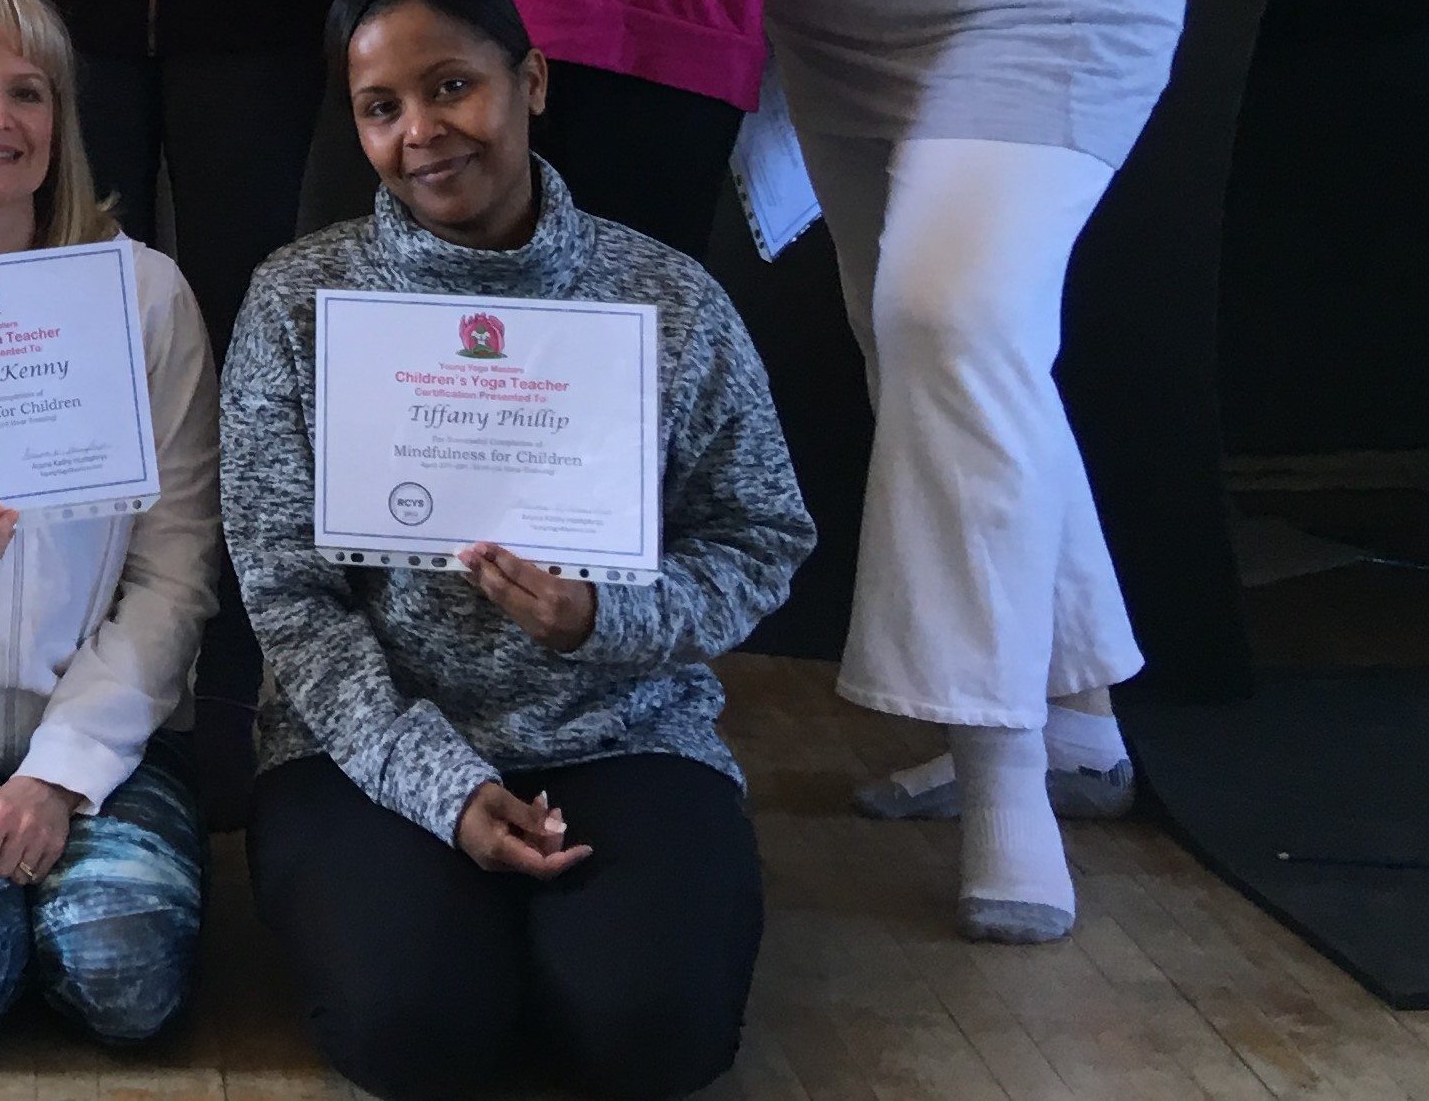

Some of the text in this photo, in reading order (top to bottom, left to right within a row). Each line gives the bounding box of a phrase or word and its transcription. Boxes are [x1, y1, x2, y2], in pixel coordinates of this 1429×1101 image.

[5, 327, 60, 343] Teacher
[0, 360, 69, 382] Kenny
[395, 371, 570, 392] Children's Yoga Teacher
[414, 387, 477, 399] Certification
[478, 391, 531, 403] Presented
[20, 398, 82, 415] Children
[408, 403, 569, 434] Tiffany Phillip
[394, 444, 582, 466] Mindfulness for Children
[397, 498, 424, 508] RCYS
